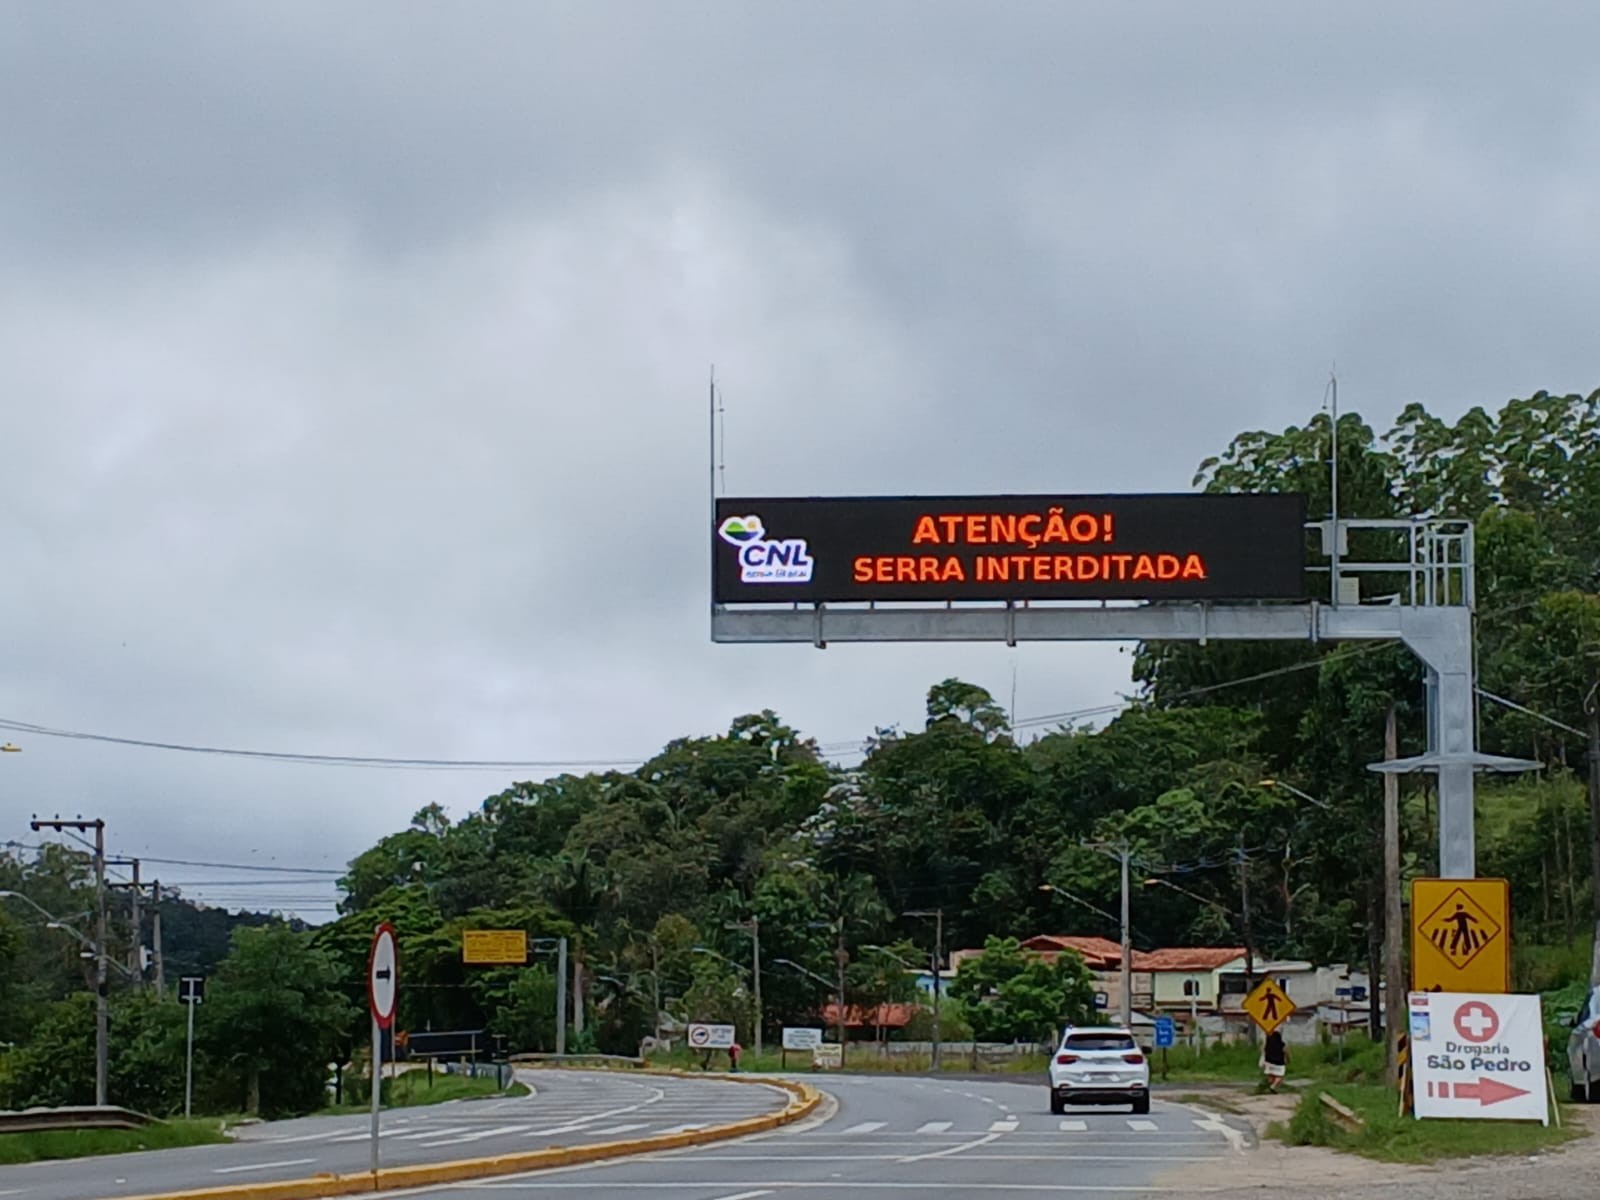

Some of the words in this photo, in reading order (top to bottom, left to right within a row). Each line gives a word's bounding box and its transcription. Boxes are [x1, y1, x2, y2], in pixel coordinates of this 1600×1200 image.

[912, 507, 1113, 549] ATENÇÃO!
[744, 544, 808, 566] CNL
[854, 556, 965, 582] SERRA
[976, 555, 1205, 581] INTERDITADA
[1446, 1041, 1510, 1056] Drogaria
[1427, 1054, 1466, 1070] São
[1470, 1056, 1532, 1072] Pedro
